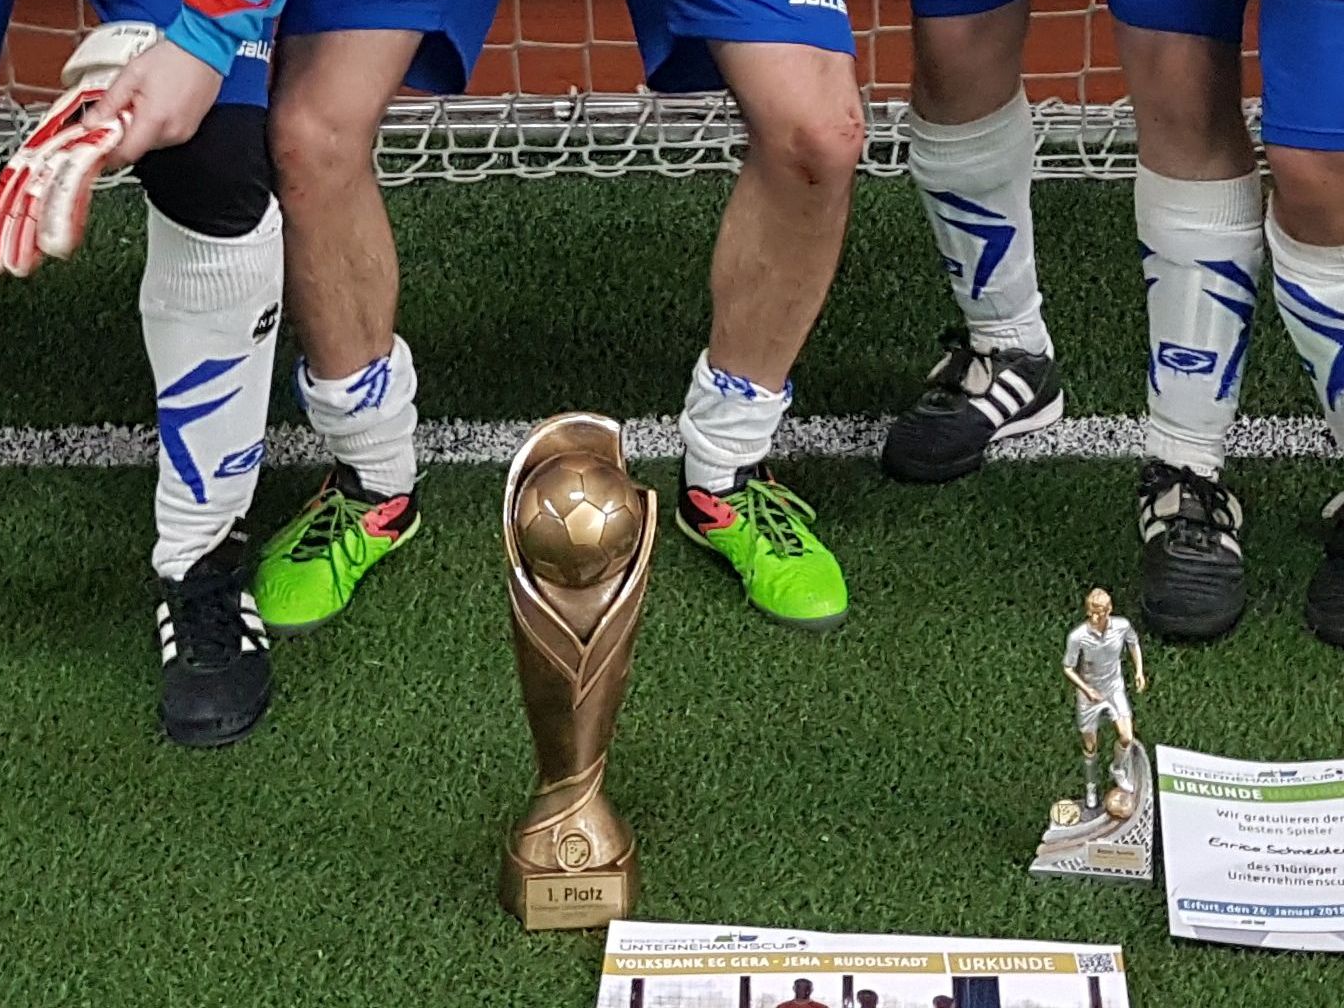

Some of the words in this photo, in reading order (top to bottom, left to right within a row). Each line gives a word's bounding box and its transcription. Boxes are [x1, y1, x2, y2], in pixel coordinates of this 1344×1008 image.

[1173, 779, 1264, 801] URKUNDE
[1216, 808, 1239, 820] Wir
[1243, 812, 1319, 824] gratulieren
[1238, 823, 1283, 835] besten
[1286, 826, 1333, 837] Spieler
[1247, 860, 1271, 872] des
[1274, 863, 1338, 875] Thüringer
[564, 886, 604, 902] Platz
[1182, 899, 1225, 913] Erfurt,
[1226, 901, 1250, 914] den
[1275, 906, 1316, 917] Januar
[619, 942, 798, 952] UNTERNEHMENSCUP
[615, 957, 704, 970] VOLKSBANK
[708, 957, 727, 969] EG
[730, 956, 770, 968] GERA
[833, 956, 928, 968] RUDOLSTADT
[958, 956, 1056, 971] URKUNDE
